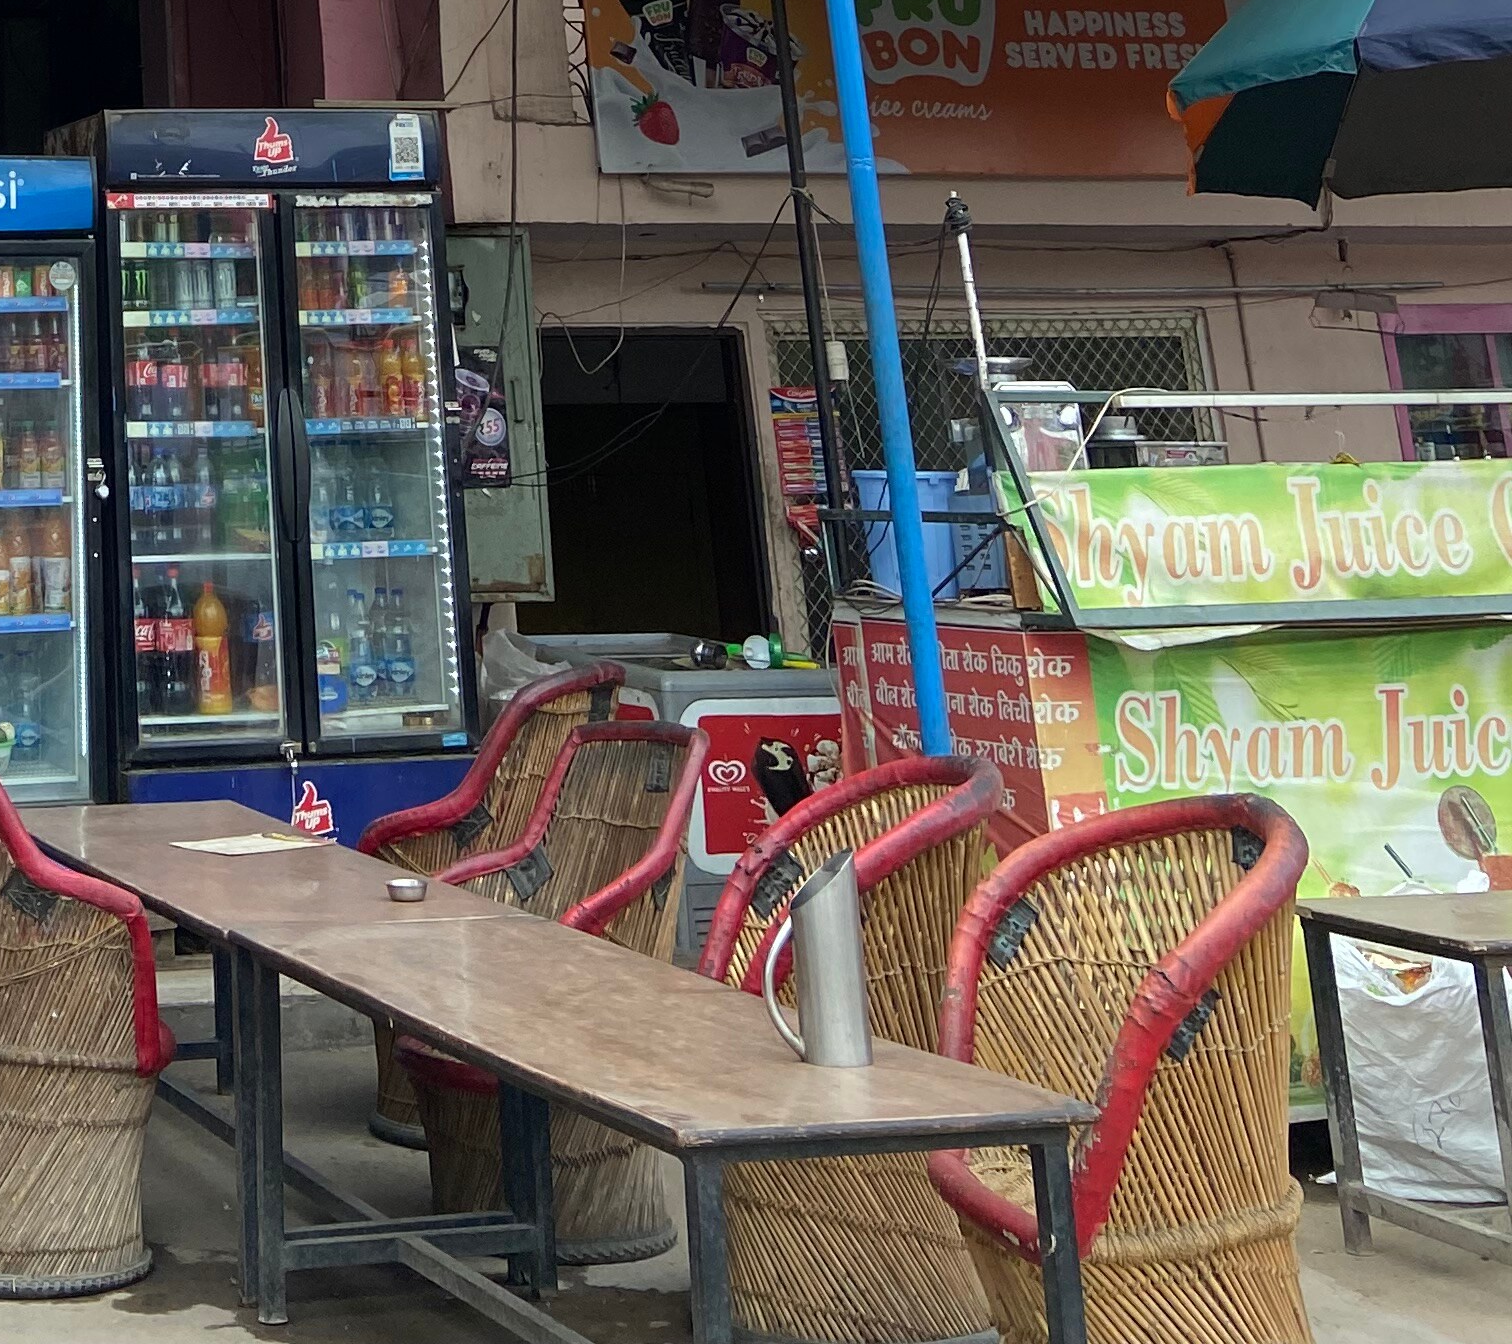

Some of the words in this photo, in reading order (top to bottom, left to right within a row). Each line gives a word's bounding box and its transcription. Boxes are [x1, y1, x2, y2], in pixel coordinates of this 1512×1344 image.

[1023, 10, 1186, 38] HAPPINESS
[861, 27, 981, 73] BON
[1004, 41, 1118, 70] SERVED
[870, 94, 906, 119] ice
[910, 100, 993, 121] creams
[258, 138, 289, 153] Thums
[1040, 480, 1270, 607] Shyam
[1291, 477, 1469, 590] Juice
[1119, 694, 1351, 792] Shyam
[295, 807, 328, 825] Thums
